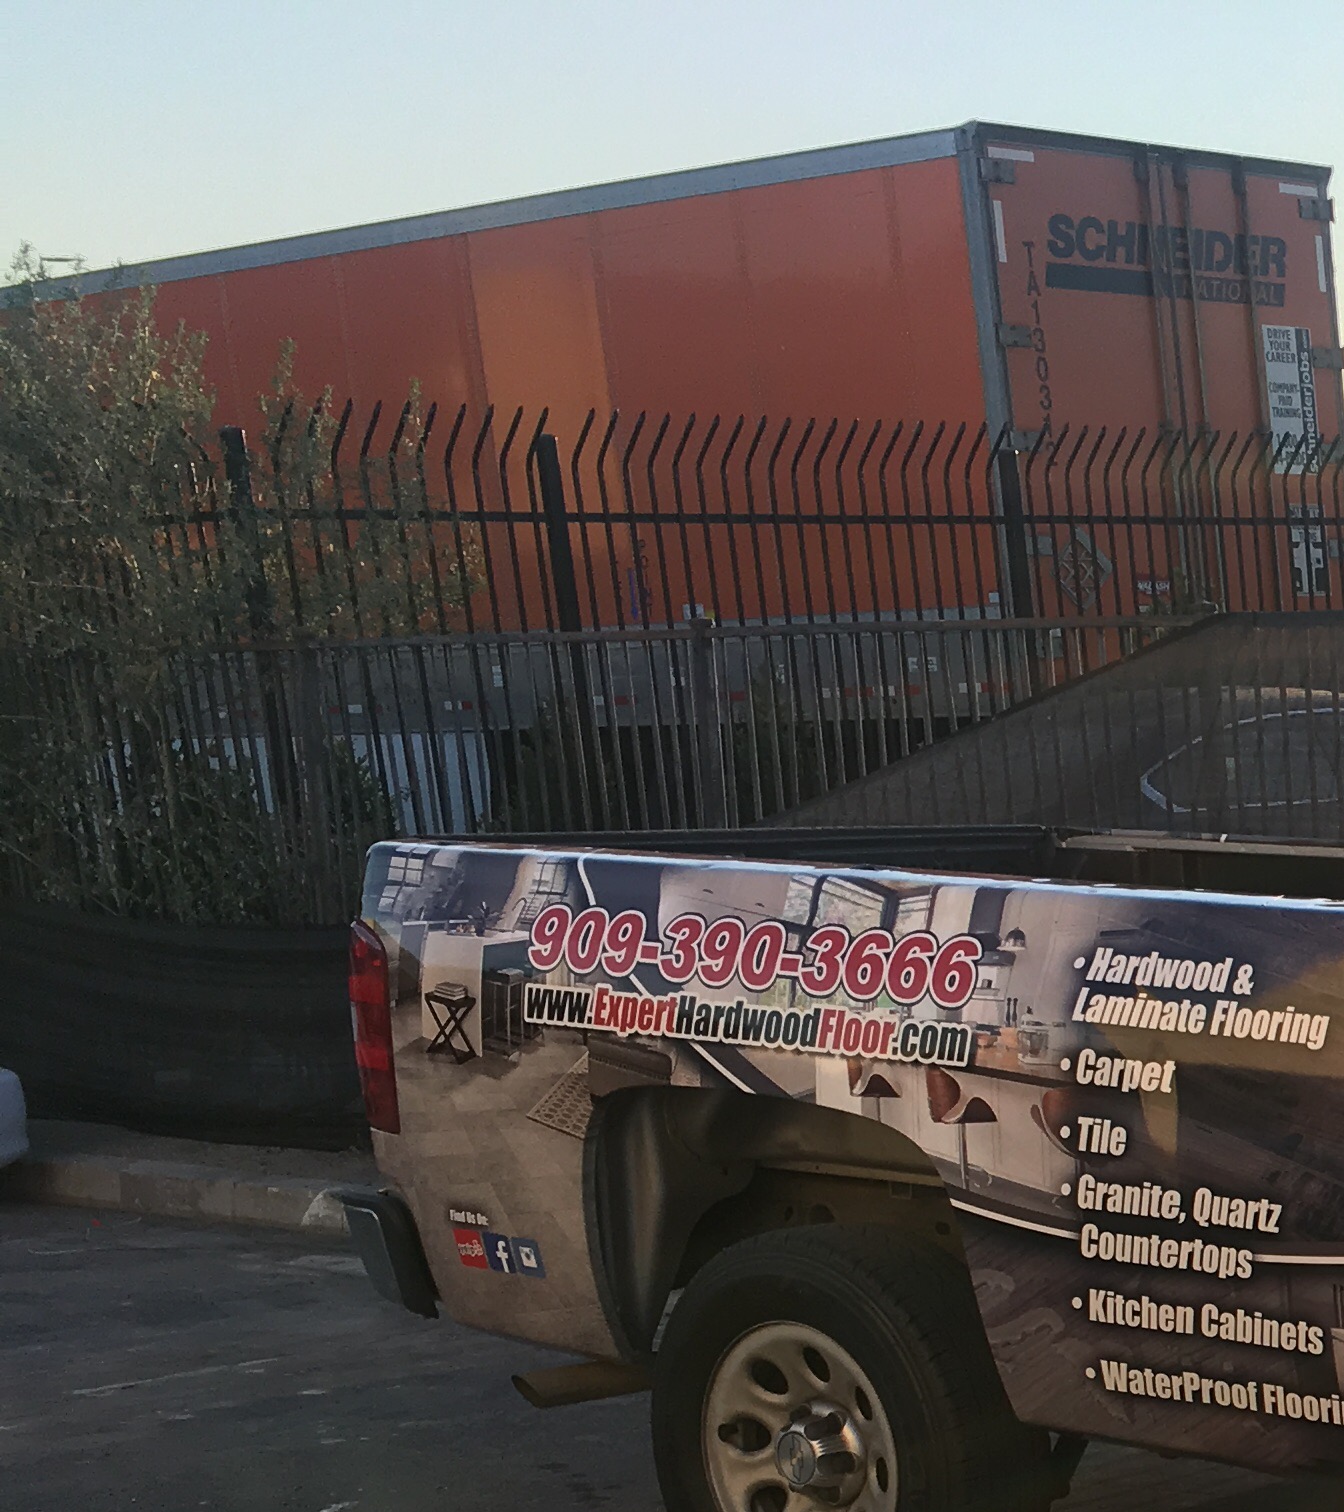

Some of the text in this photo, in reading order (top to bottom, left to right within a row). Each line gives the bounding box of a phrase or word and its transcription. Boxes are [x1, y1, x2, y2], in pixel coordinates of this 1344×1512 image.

[1047, 213, 1287, 278] SCHNEIDER
[1180, 278, 1281, 306] NATIOAL
[1265, 351, 1297, 364] CAREER
[529, 904, 981, 1008] 909-390-3666
[1086, 947, 1254, 995] Hardwood &
[526, 985, 970, 1064] www.ExpertHardwoodFloor.com
[1071, 987, 1330, 1050] Laminate Flooring
[1076, 1048, 1176, 1093] Carpet
[1077, 1117, 1127, 1156] Tile
[1077, 1174, 1282, 1234] Granite, Quartz
[1080, 1223, 1254, 1280] Countertops
[1089, 1288, 1324, 1355] Kitchen Cabinets
[1100, 1359, 1258, 1411] WaterProof
